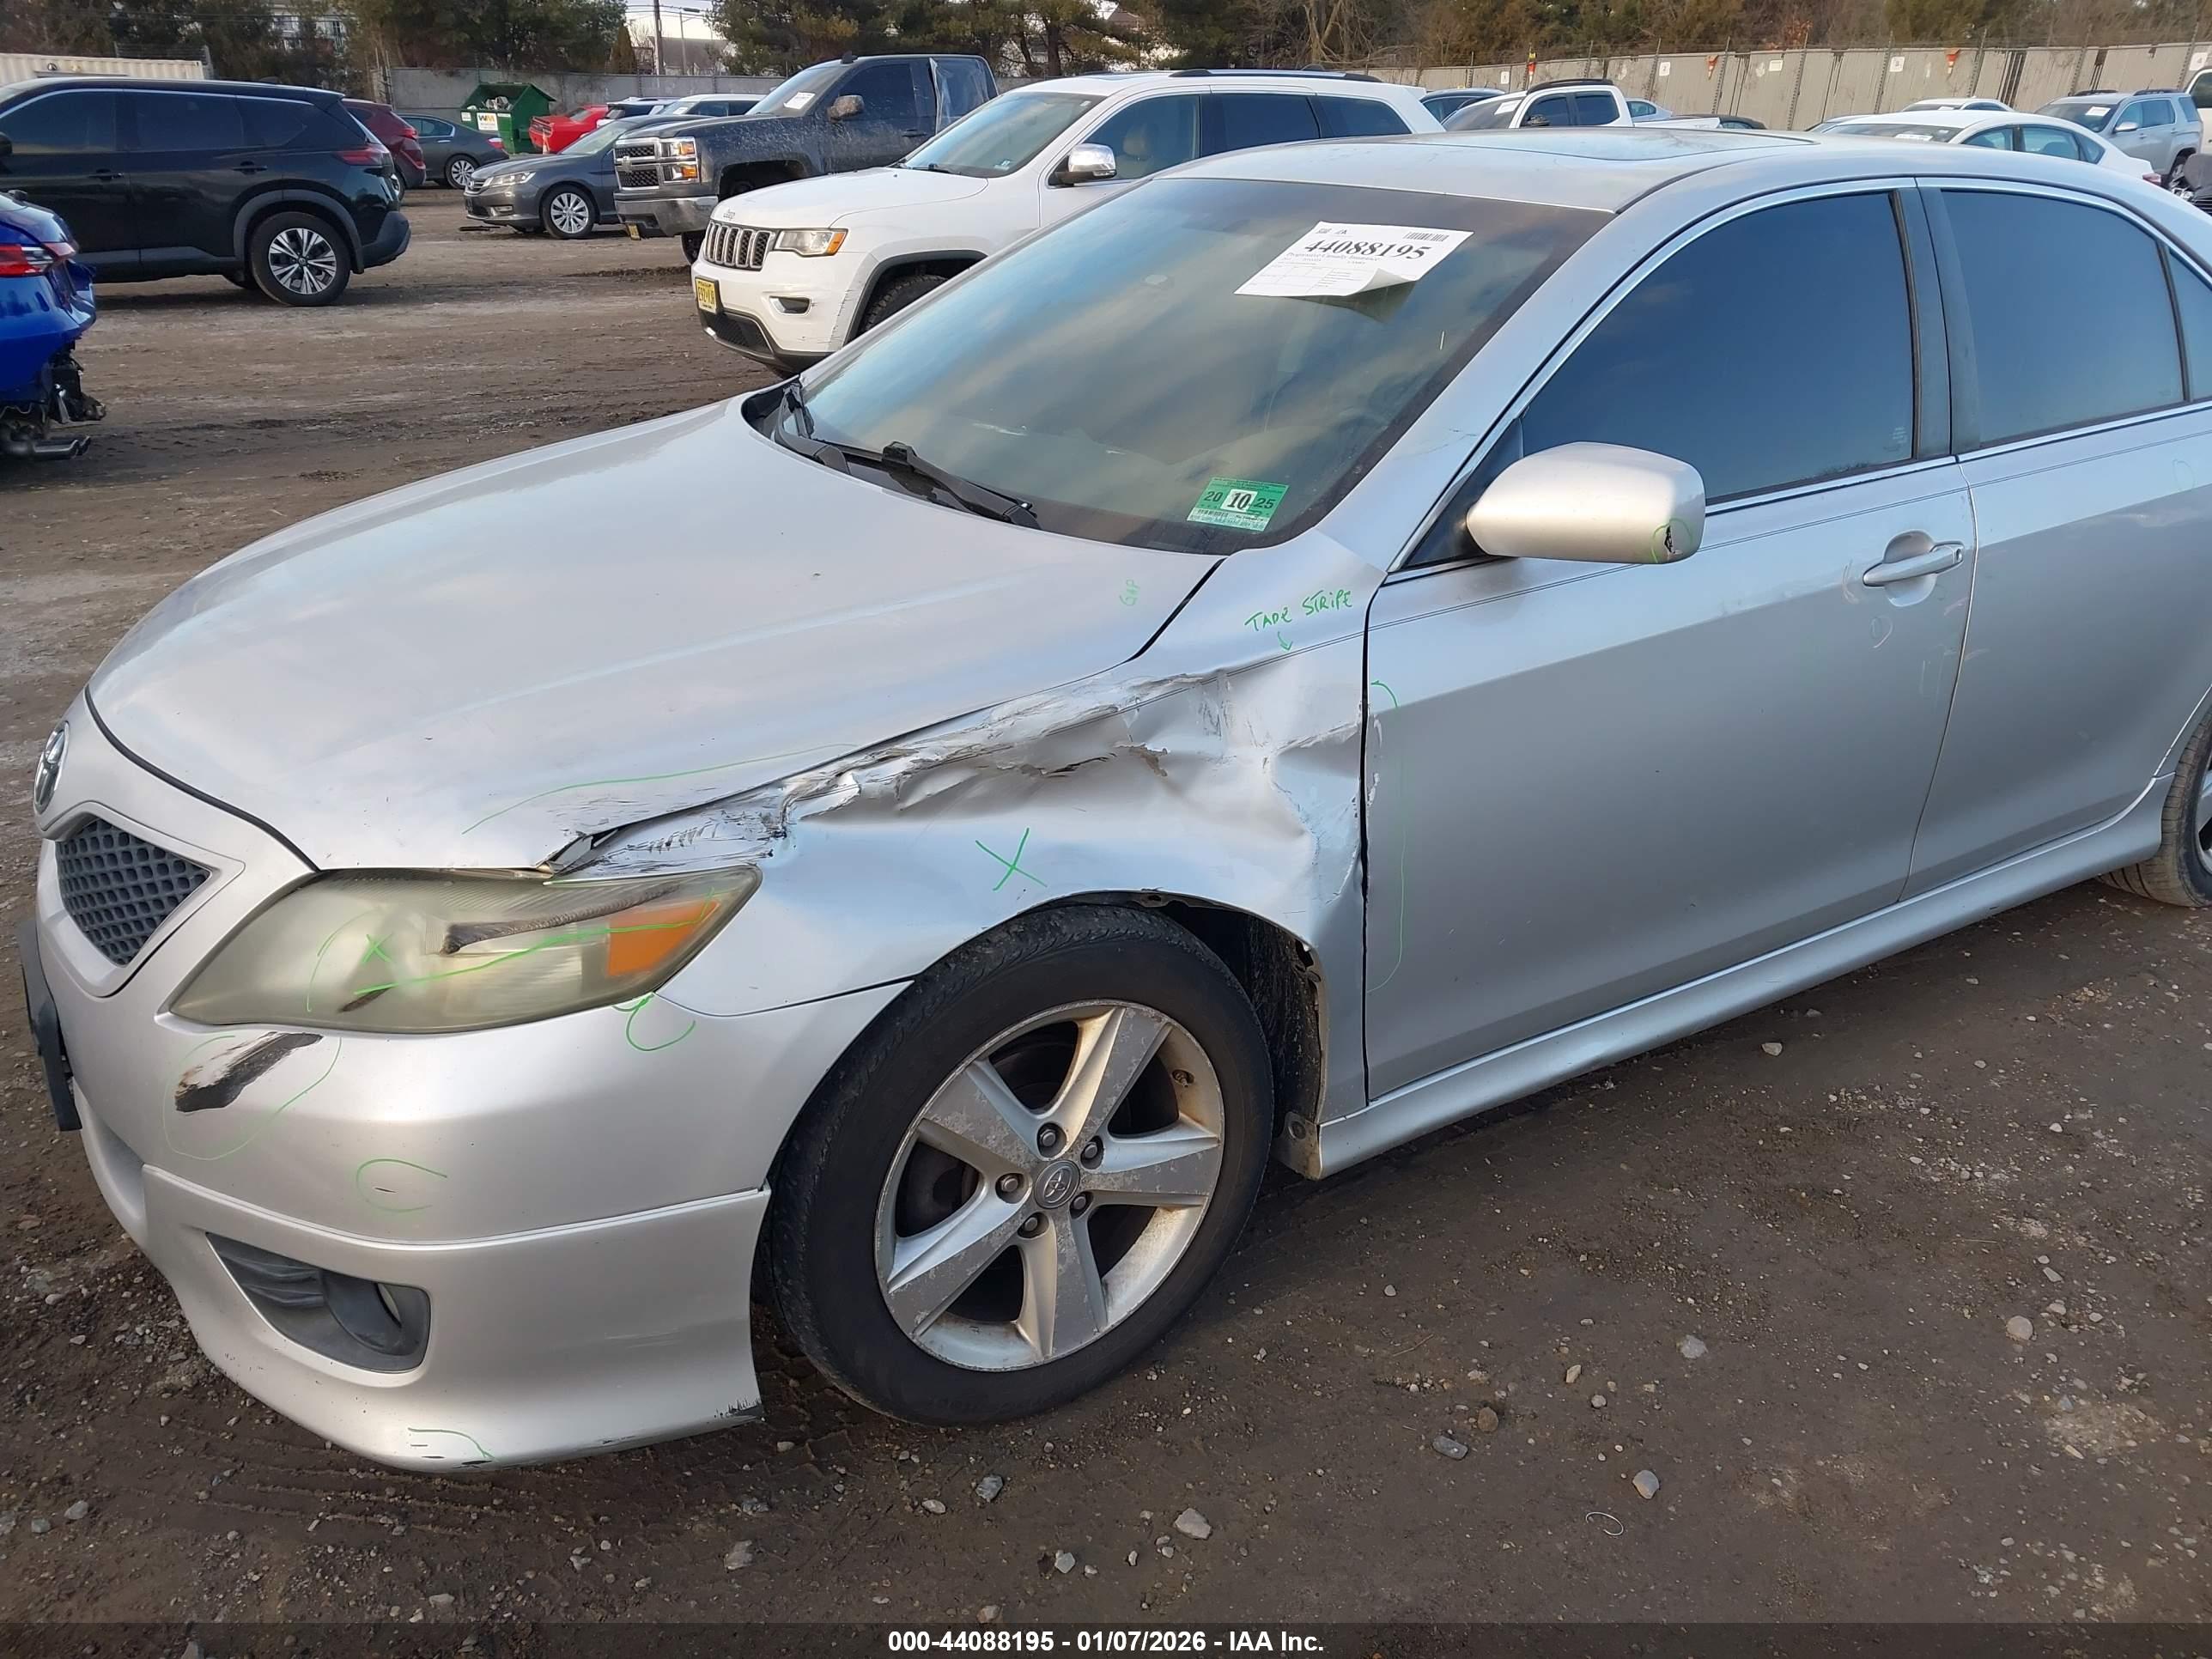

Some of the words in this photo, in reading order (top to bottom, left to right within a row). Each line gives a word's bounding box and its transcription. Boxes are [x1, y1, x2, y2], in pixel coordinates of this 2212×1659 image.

[1304, 240, 1432, 259] 44088195
[1203, 490, 1224, 502] 20
[1226, 492, 1252, 510] 10
[1254, 497, 1276, 509] 25
